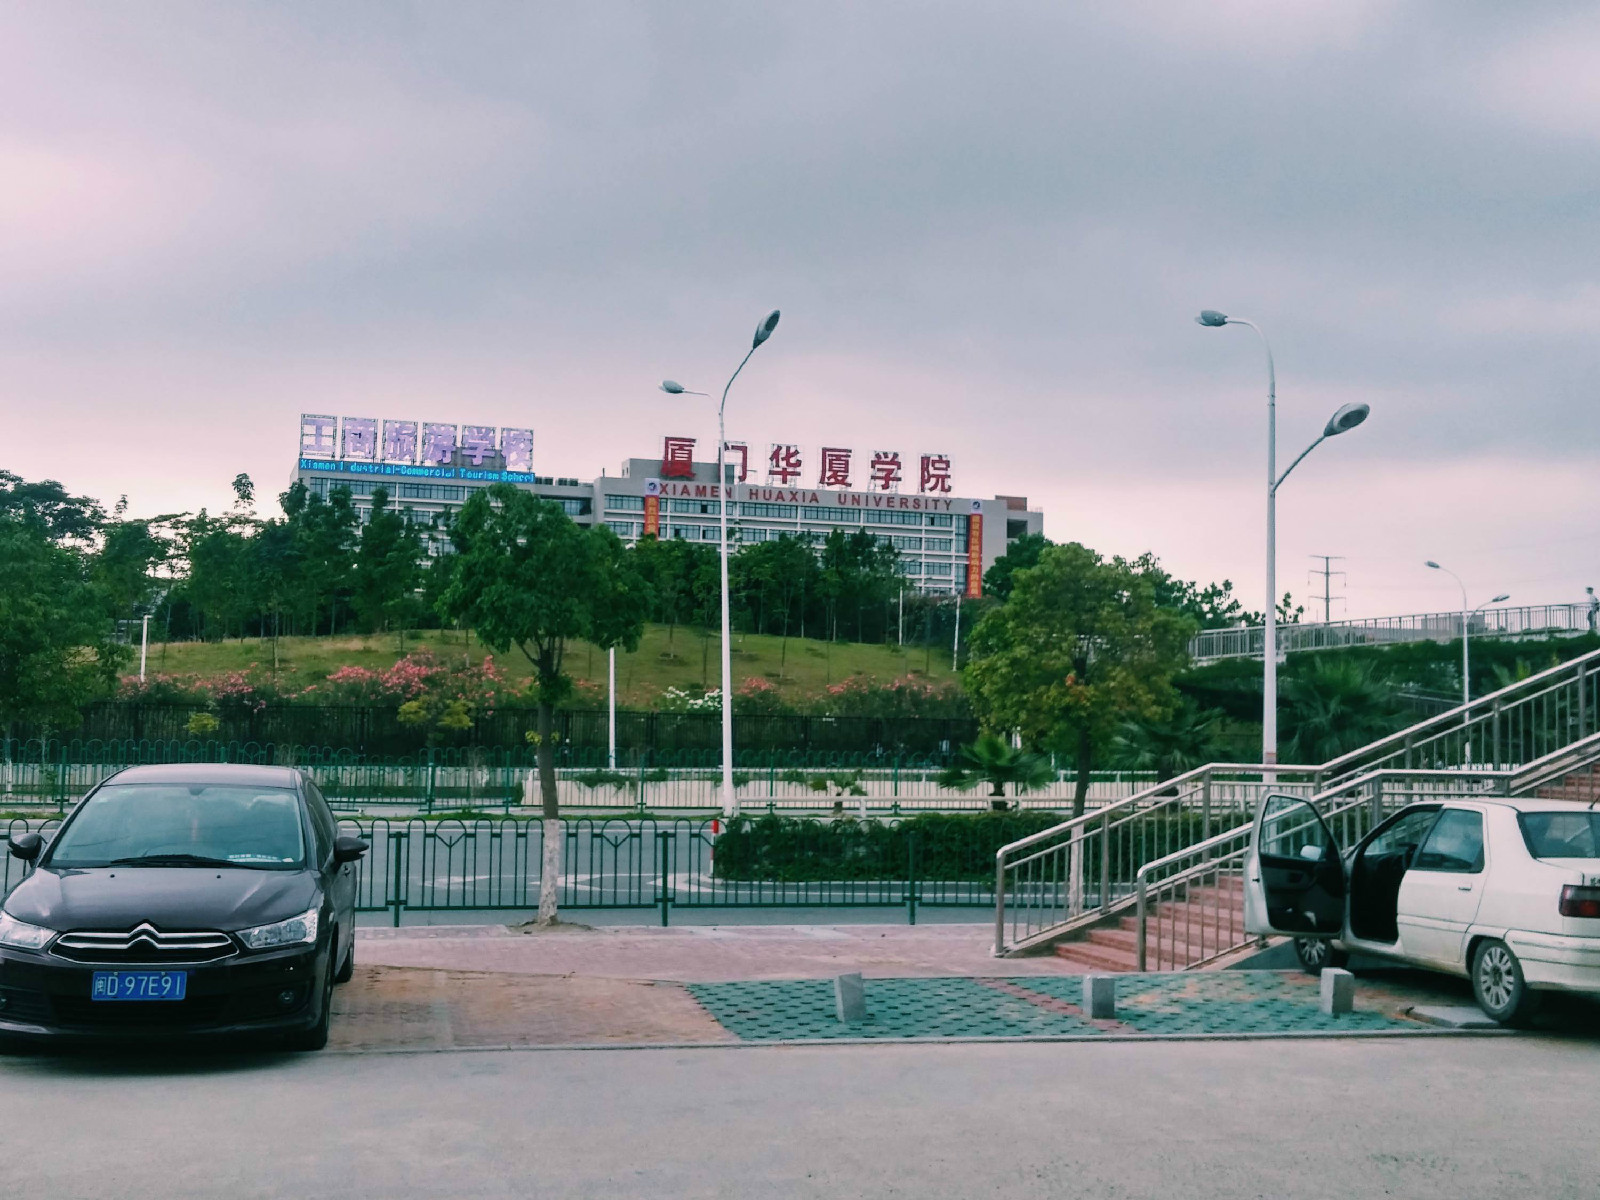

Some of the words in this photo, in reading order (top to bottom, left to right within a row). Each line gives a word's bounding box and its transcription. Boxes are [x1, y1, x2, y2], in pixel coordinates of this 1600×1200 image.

[302, 417, 533, 467] 工商旅游学校
[339, 463, 455, 477] Idustrial-Commercial
[459, 468, 499, 480] Tourism
[660, 436, 953, 493] 厦门华厦学院
[659, 482, 732, 498] XIAMEN
[749, 488, 820, 503] HUAXIA
[837, 493, 953, 511] UNIVERSITY
